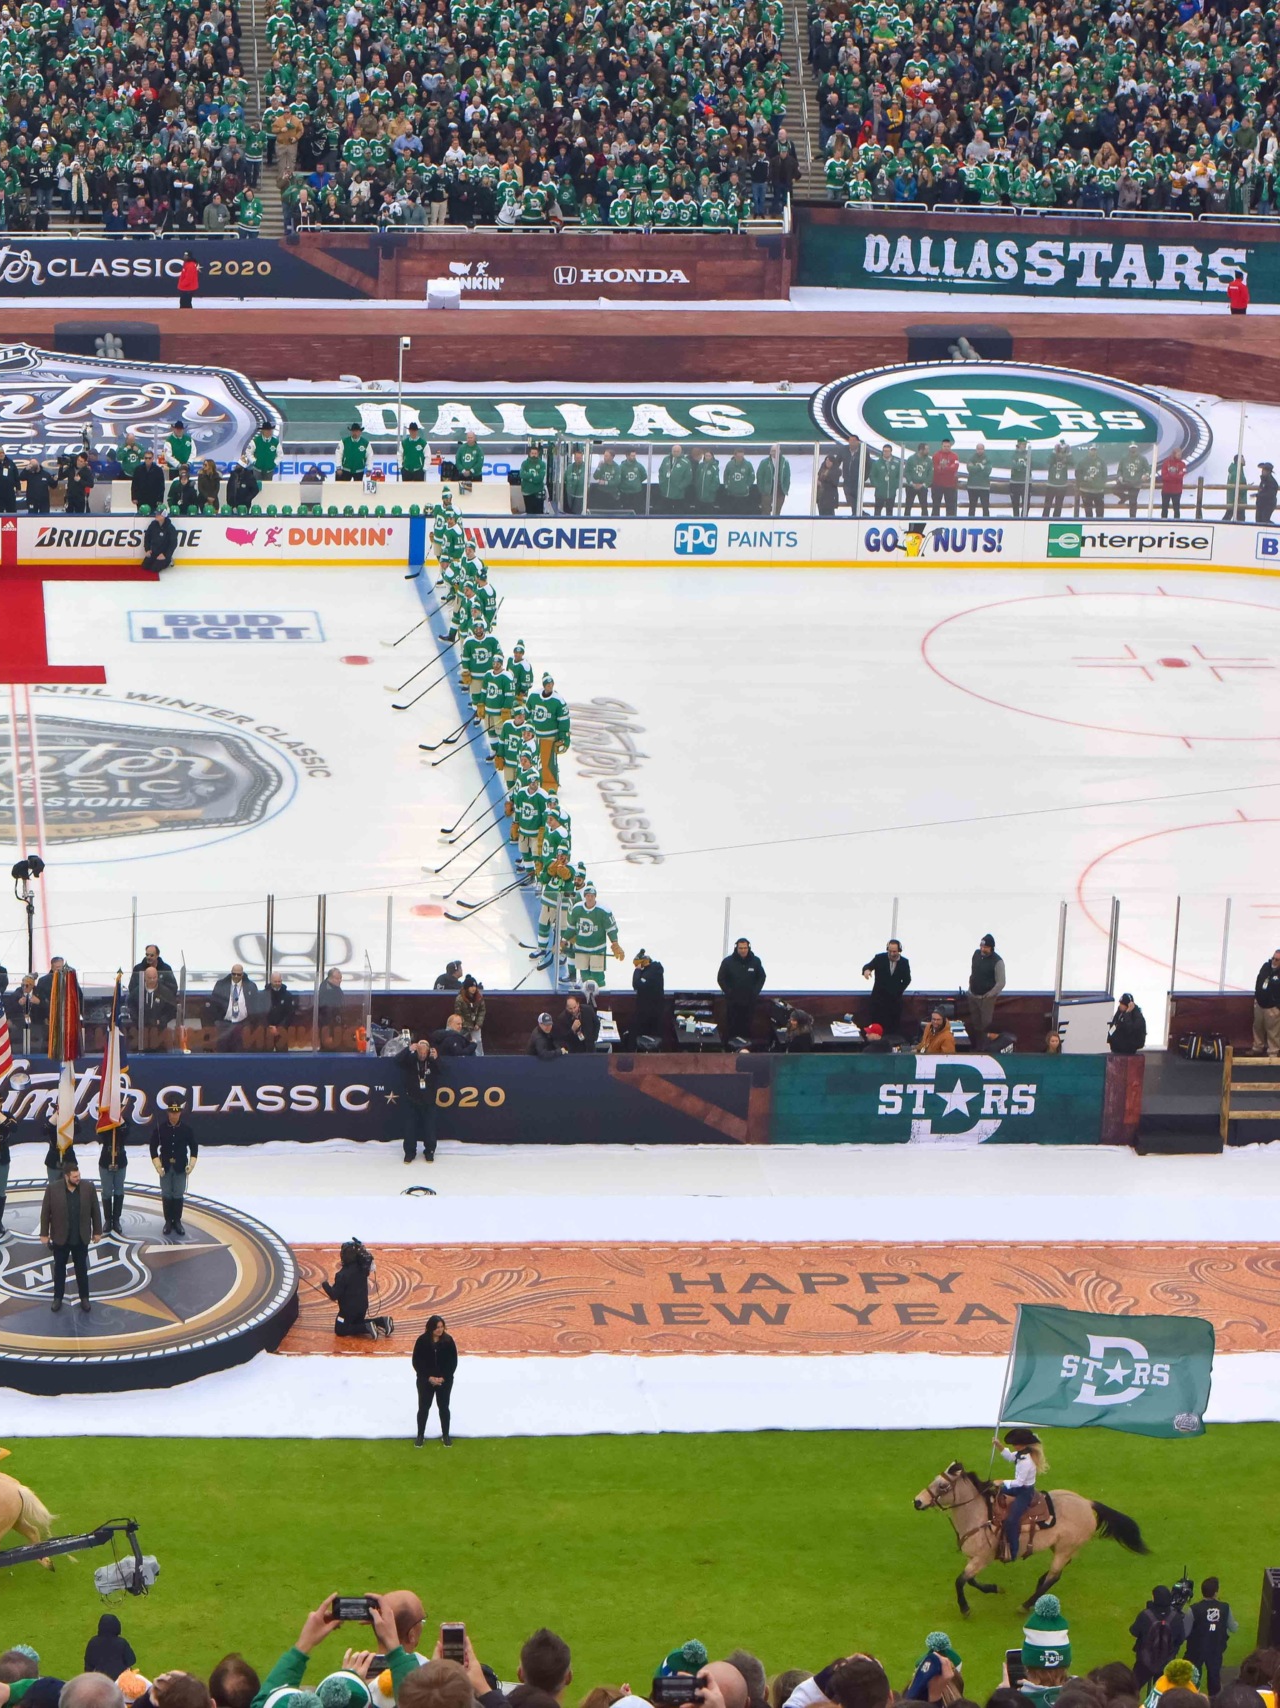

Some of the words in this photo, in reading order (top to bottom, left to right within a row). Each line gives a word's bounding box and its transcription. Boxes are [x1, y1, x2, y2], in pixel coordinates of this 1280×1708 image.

[47, 258, 185, 277] CLASSIC
[208, 260, 272, 276] 2020
[862, 233, 1019, 280] DALLAS
[1023, 241, 1249, 292] STARS
[437, 276, 504, 290] NKIN'
[580, 269, 690, 283] HONDA
[354, 402, 756, 437] DALLAS
[274, 462, 336, 475] EICO
[34, 527, 203, 547] BRIDGESNE
[288, 526, 393, 546] DUNKIN'
[484, 527, 618, 549] WAGNER
[675, 528, 718, 553] PPG
[728, 531, 799, 548] PAINTS
[864, 527, 898, 553] GO
[933, 527, 1003, 554] NUTS!
[1057, 530, 1209, 553] enterprise
[163, 614, 284, 627] BUD
[141, 626, 311, 640] LIGHT
[33, 685, 112, 697] NHL
[124, 691, 255, 726] WINTER
[254, 724, 332, 779] CLASSIC
[54, 820, 143, 835] TEXAS
[596, 778, 666, 866] CLASSIC
[155, 1084, 371, 1114] CLASSIC
[434, 1086, 506, 1108] 020
[22, 1248, 113, 1289] NL
[668, 1271, 962, 1294] HAPPY
[587, 1302, 792, 1326] NEW
[829, 1302, 1020, 1326] YEA
